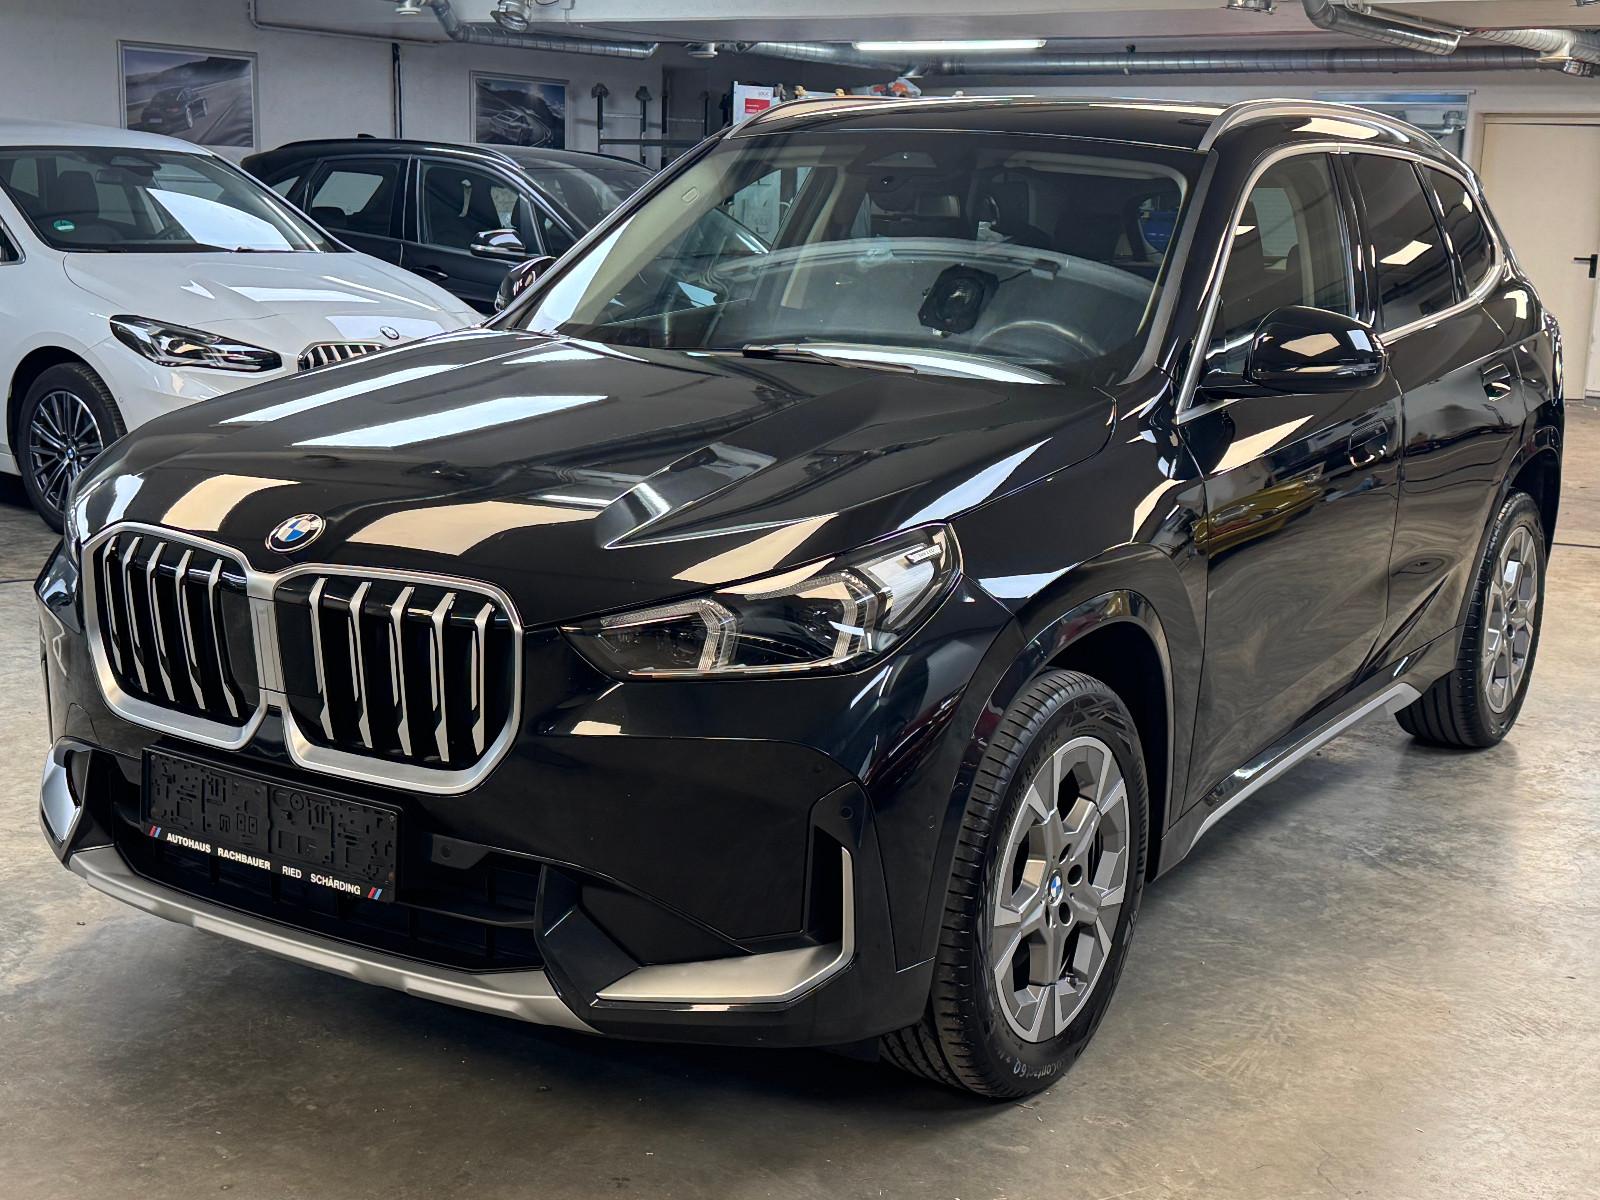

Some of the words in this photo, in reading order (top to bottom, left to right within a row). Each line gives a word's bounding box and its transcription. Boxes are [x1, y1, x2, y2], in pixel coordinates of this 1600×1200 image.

[166, 832, 211, 854] AUTOHAUS
[217, 847, 271, 870] RACHBAUER
[282, 865, 302, 879] RIED
[310, 872, 361, 895] SCHÄRDING
